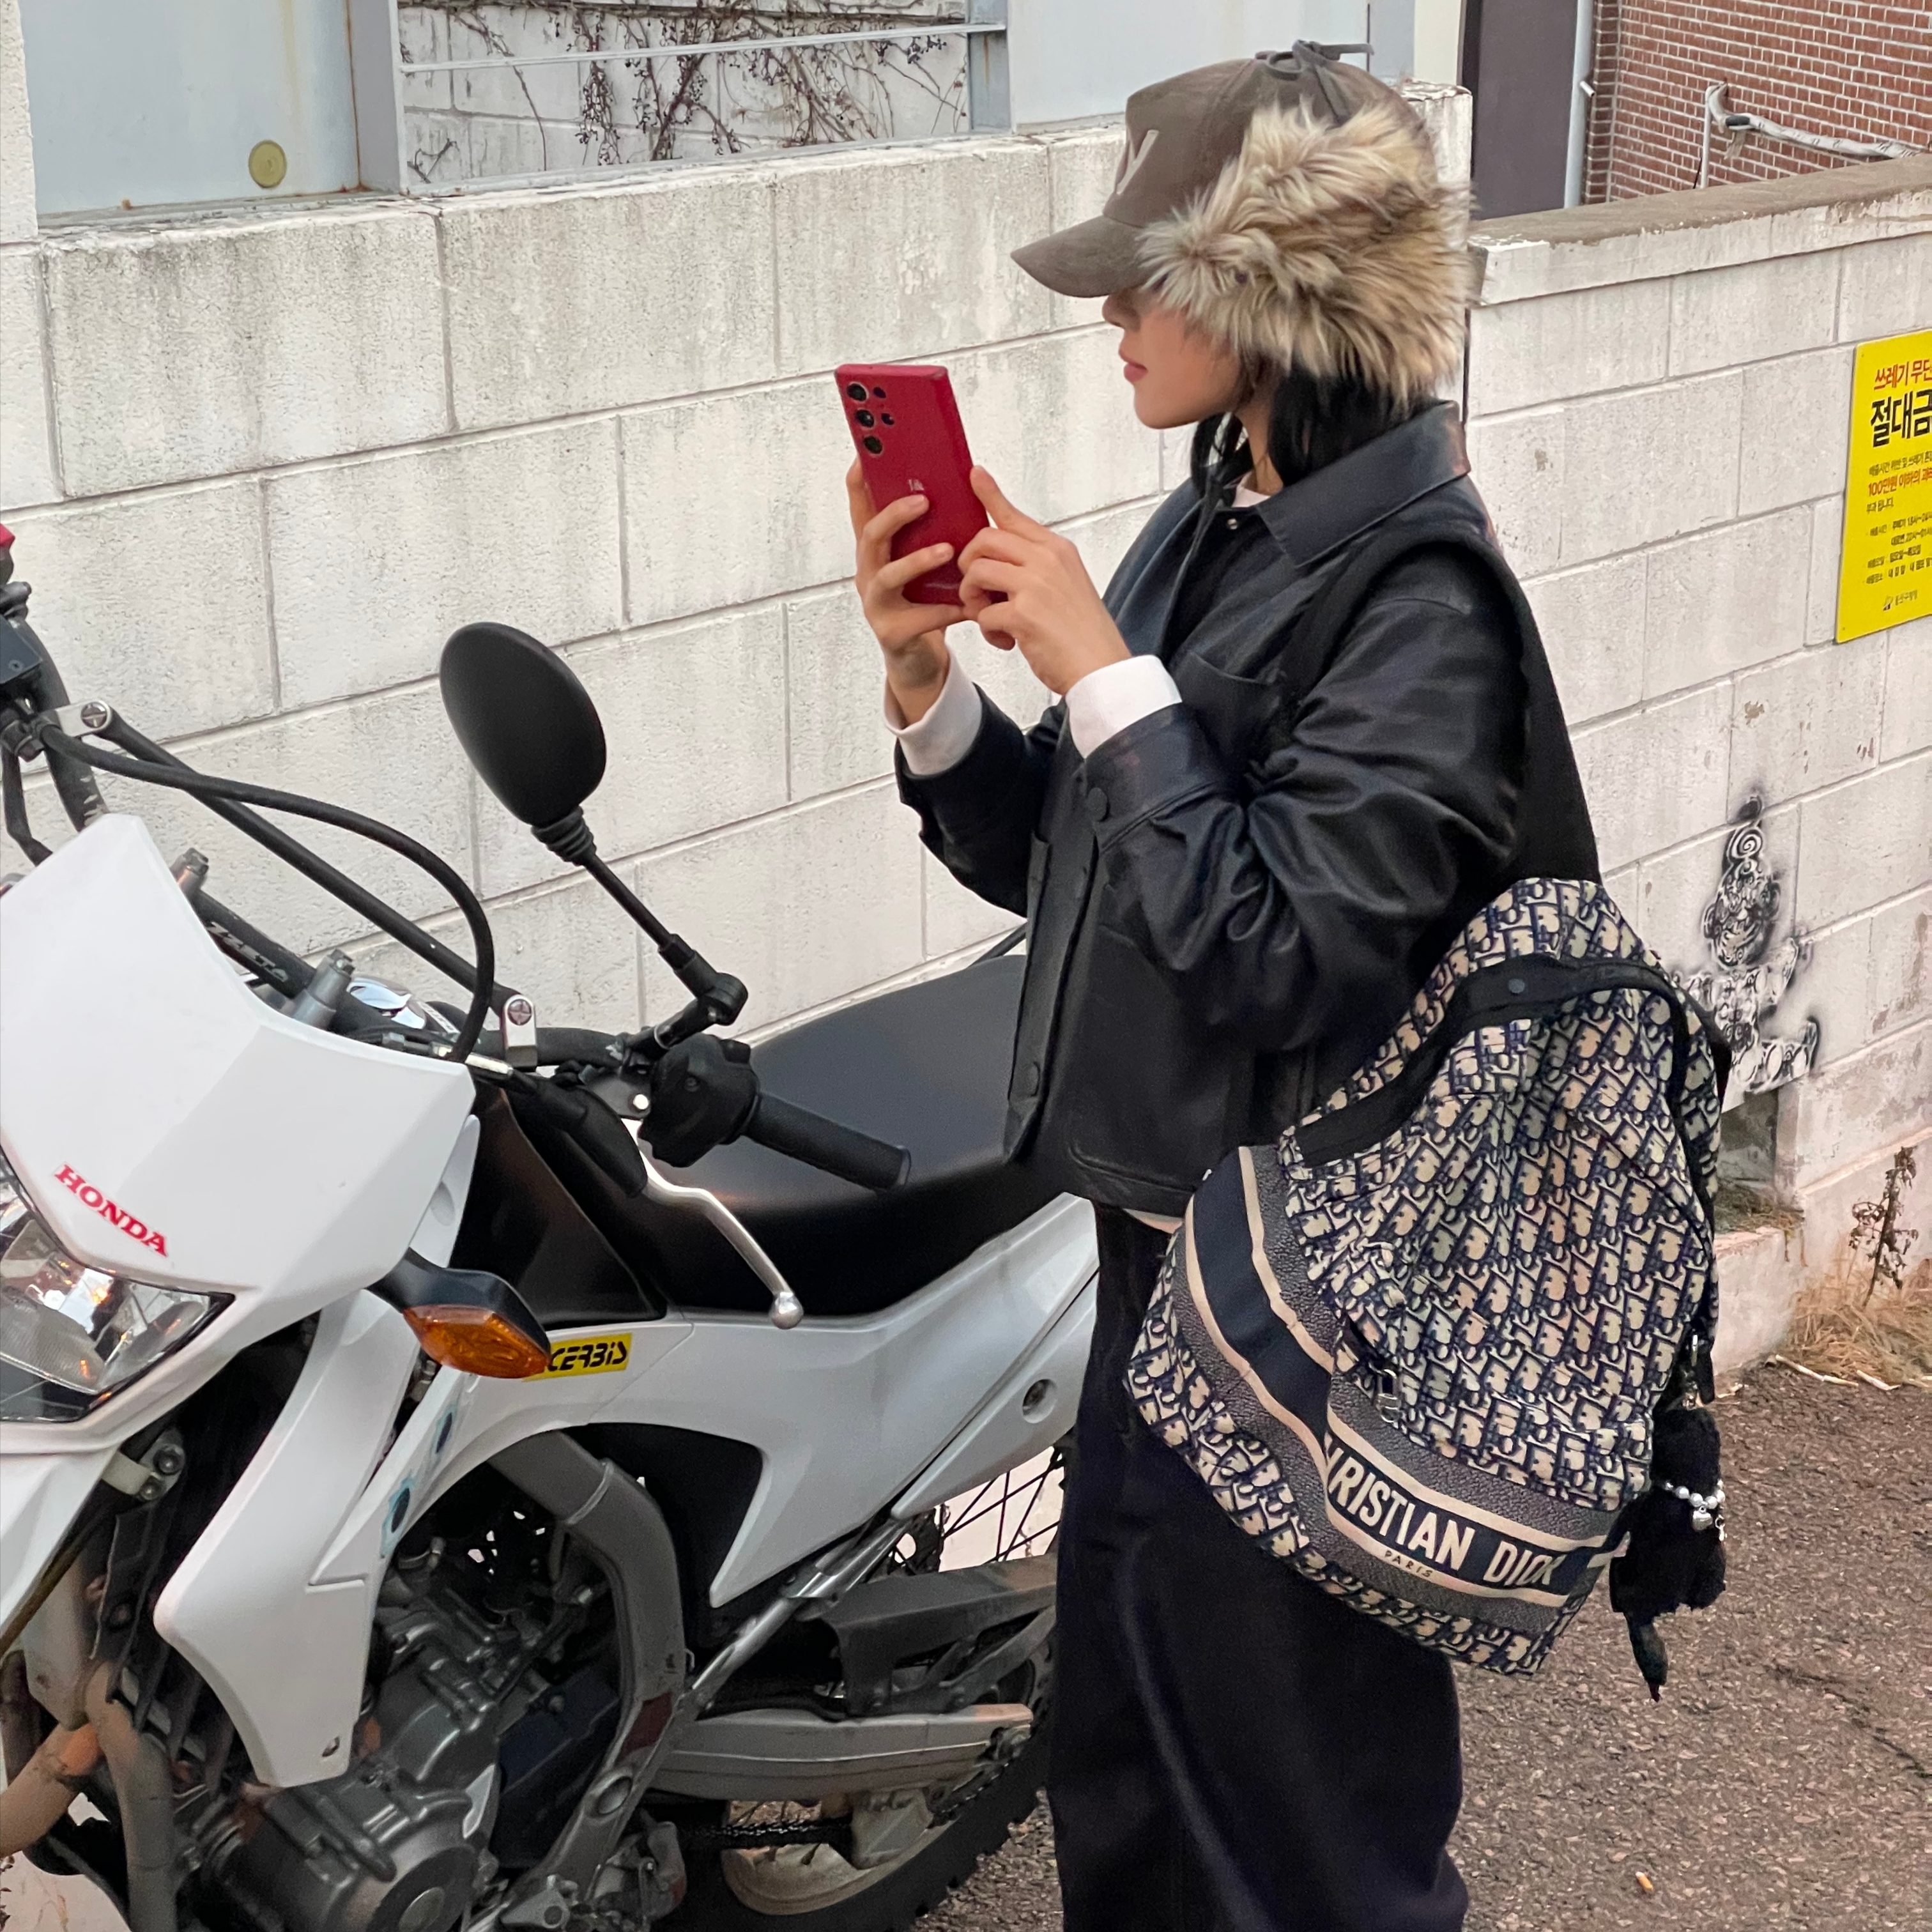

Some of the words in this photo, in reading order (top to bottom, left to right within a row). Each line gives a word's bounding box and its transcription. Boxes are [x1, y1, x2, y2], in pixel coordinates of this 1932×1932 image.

[1873, 361, 1909, 390] 쓰레기
[1870, 388, 1932, 448] 절대금
[1868, 475, 1897, 496] 100만원
[1898, 468, 1920, 489] 이하의
[54, 1163, 169, 1257] HONDA
[1384, 1550, 1433, 1577] PARIS
